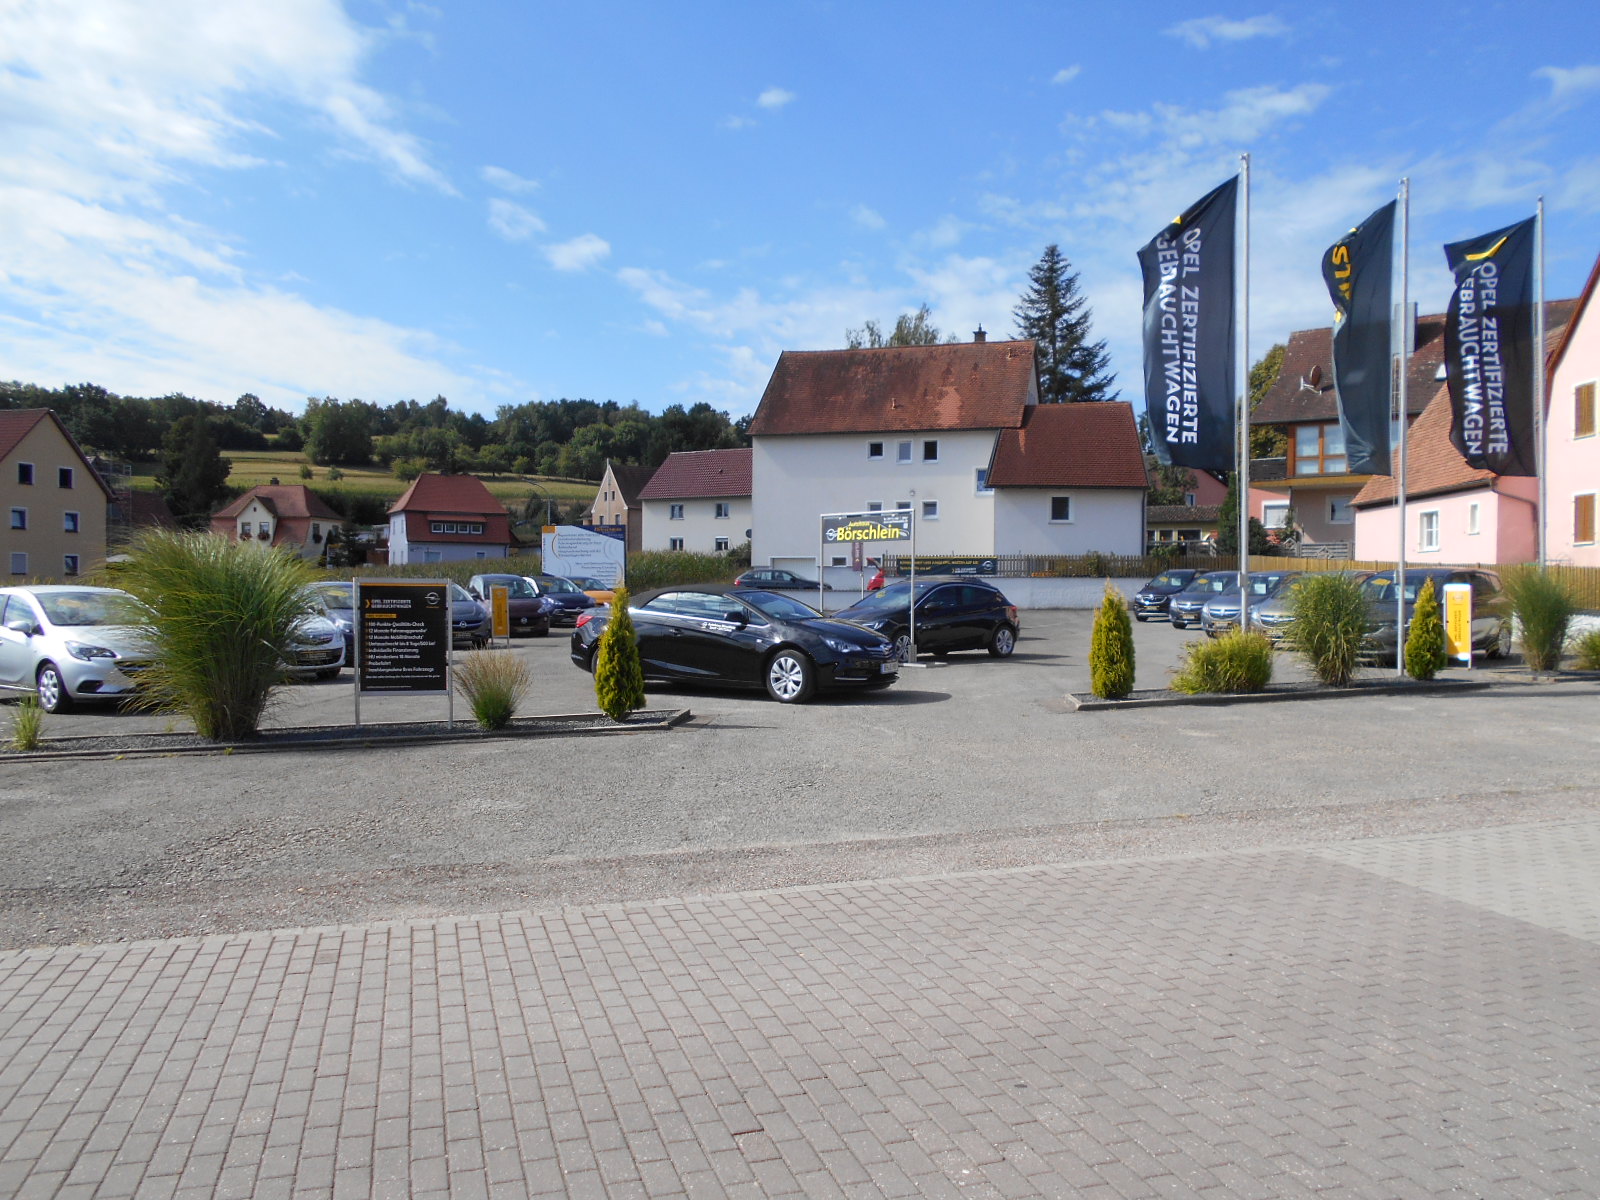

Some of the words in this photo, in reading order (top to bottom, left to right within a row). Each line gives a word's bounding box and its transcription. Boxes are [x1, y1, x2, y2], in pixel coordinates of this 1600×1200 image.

[1182, 227, 1201, 279] OPEL
[1479, 260, 1497, 310] OPEL
[1181, 285, 1200, 445] ZERTIFIZIERTE
[1458, 268, 1484, 456] EBRAUCHTWAGEN
[1481, 317, 1509, 455] ZERTIFIZIERTE
[836, 524, 900, 541] Börschlein
